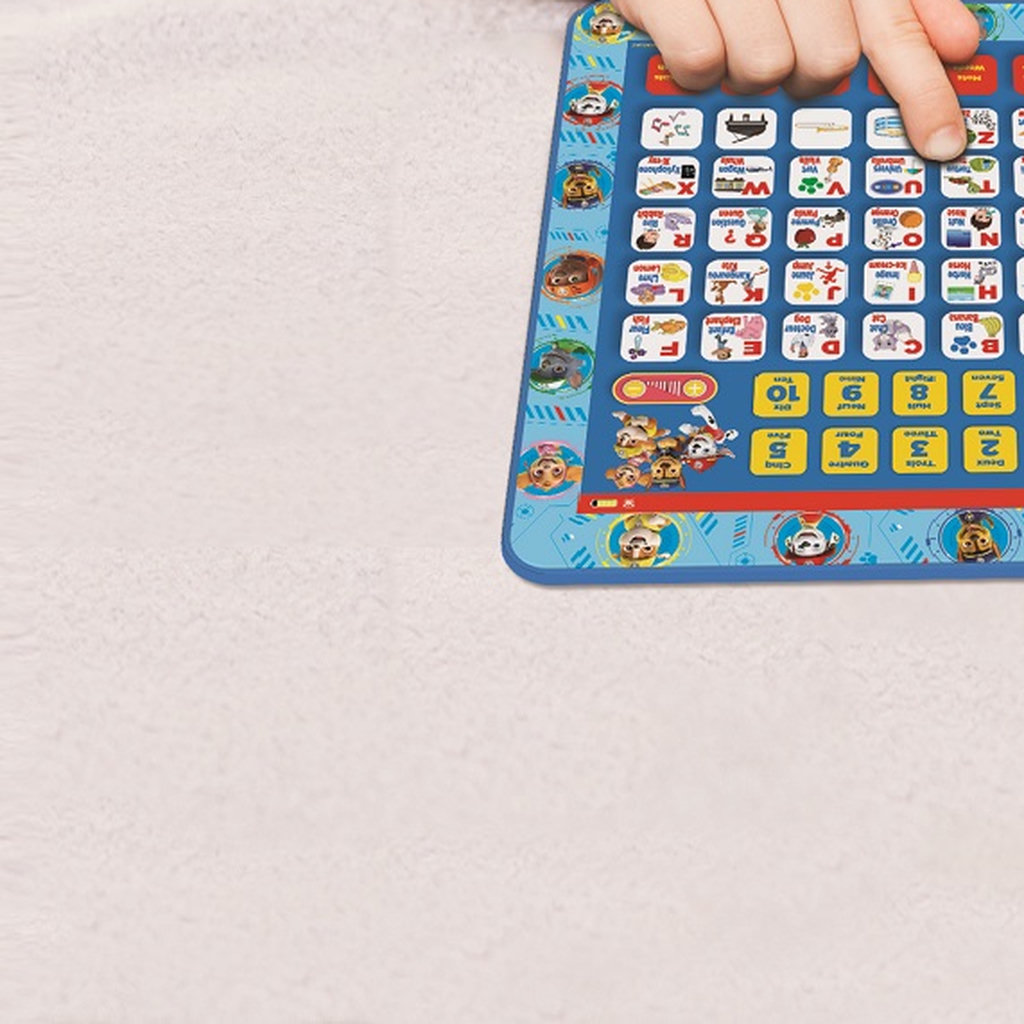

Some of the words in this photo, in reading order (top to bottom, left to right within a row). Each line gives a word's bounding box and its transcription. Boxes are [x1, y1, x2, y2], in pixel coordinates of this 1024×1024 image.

[977, 131, 995, 145] Z
[676, 181, 696, 196] X
[740, 181, 771, 196] W
[825, 181, 846, 196] V
[904, 179, 923, 195] U
[978, 179, 996, 194] T
[717, 209, 745, 219] Queen
[672, 233, 692, 248] R
[744, 233, 768, 248] Q
[826, 233, 844, 247] P
[902, 232, 923, 247] O
[980, 232, 999, 247] N
[721, 262, 738, 272] Kite
[791, 260, 815, 271] Jump
[947, 261, 971, 271] Horse
[874, 270, 900, 280] Image
[668, 288, 684, 303] L
[742, 288, 763, 303] K
[827, 286, 842, 301] J
[908, 287, 916, 302] I
[978, 285, 998, 300] H
[632, 315, 650, 326] Fish
[793, 313, 811, 325] Dog
[871, 314, 887, 324] Cat
[948, 314, 979, 324] Banana
[707, 326, 735, 336] Enfant
[868, 324, 889, 335] Chat
[659, 341, 679, 357] F
[742, 340, 762, 356] E
[820, 340, 840, 355] D
[903, 339, 922, 355] C
[980, 339, 999, 354] B
[772, 376, 793, 384] Ten
[971, 374, 1005, 382] Seven
[766, 384, 801, 403] 10
[841, 384, 862, 402] 9
[909, 383, 930, 401] 8
[978, 383, 998, 401] 7
[773, 403, 792, 412] Dix
[975, 400, 1002, 410] Sept
[766, 432, 791, 440] Five
[835, 431, 864, 439] Four
[903, 429, 938, 438] Three
[978, 429, 1001, 437] Two
[768, 441, 788, 460] 5
[837, 440, 861, 459] 4
[910, 439, 930, 458] 3
[980, 439, 1000, 457] 2
[764, 460, 792, 470] Cinq
[828, 460, 869, 469] Quatre
[905, 459, 936, 468] Trois
[976, 458, 1005, 467] Deux
